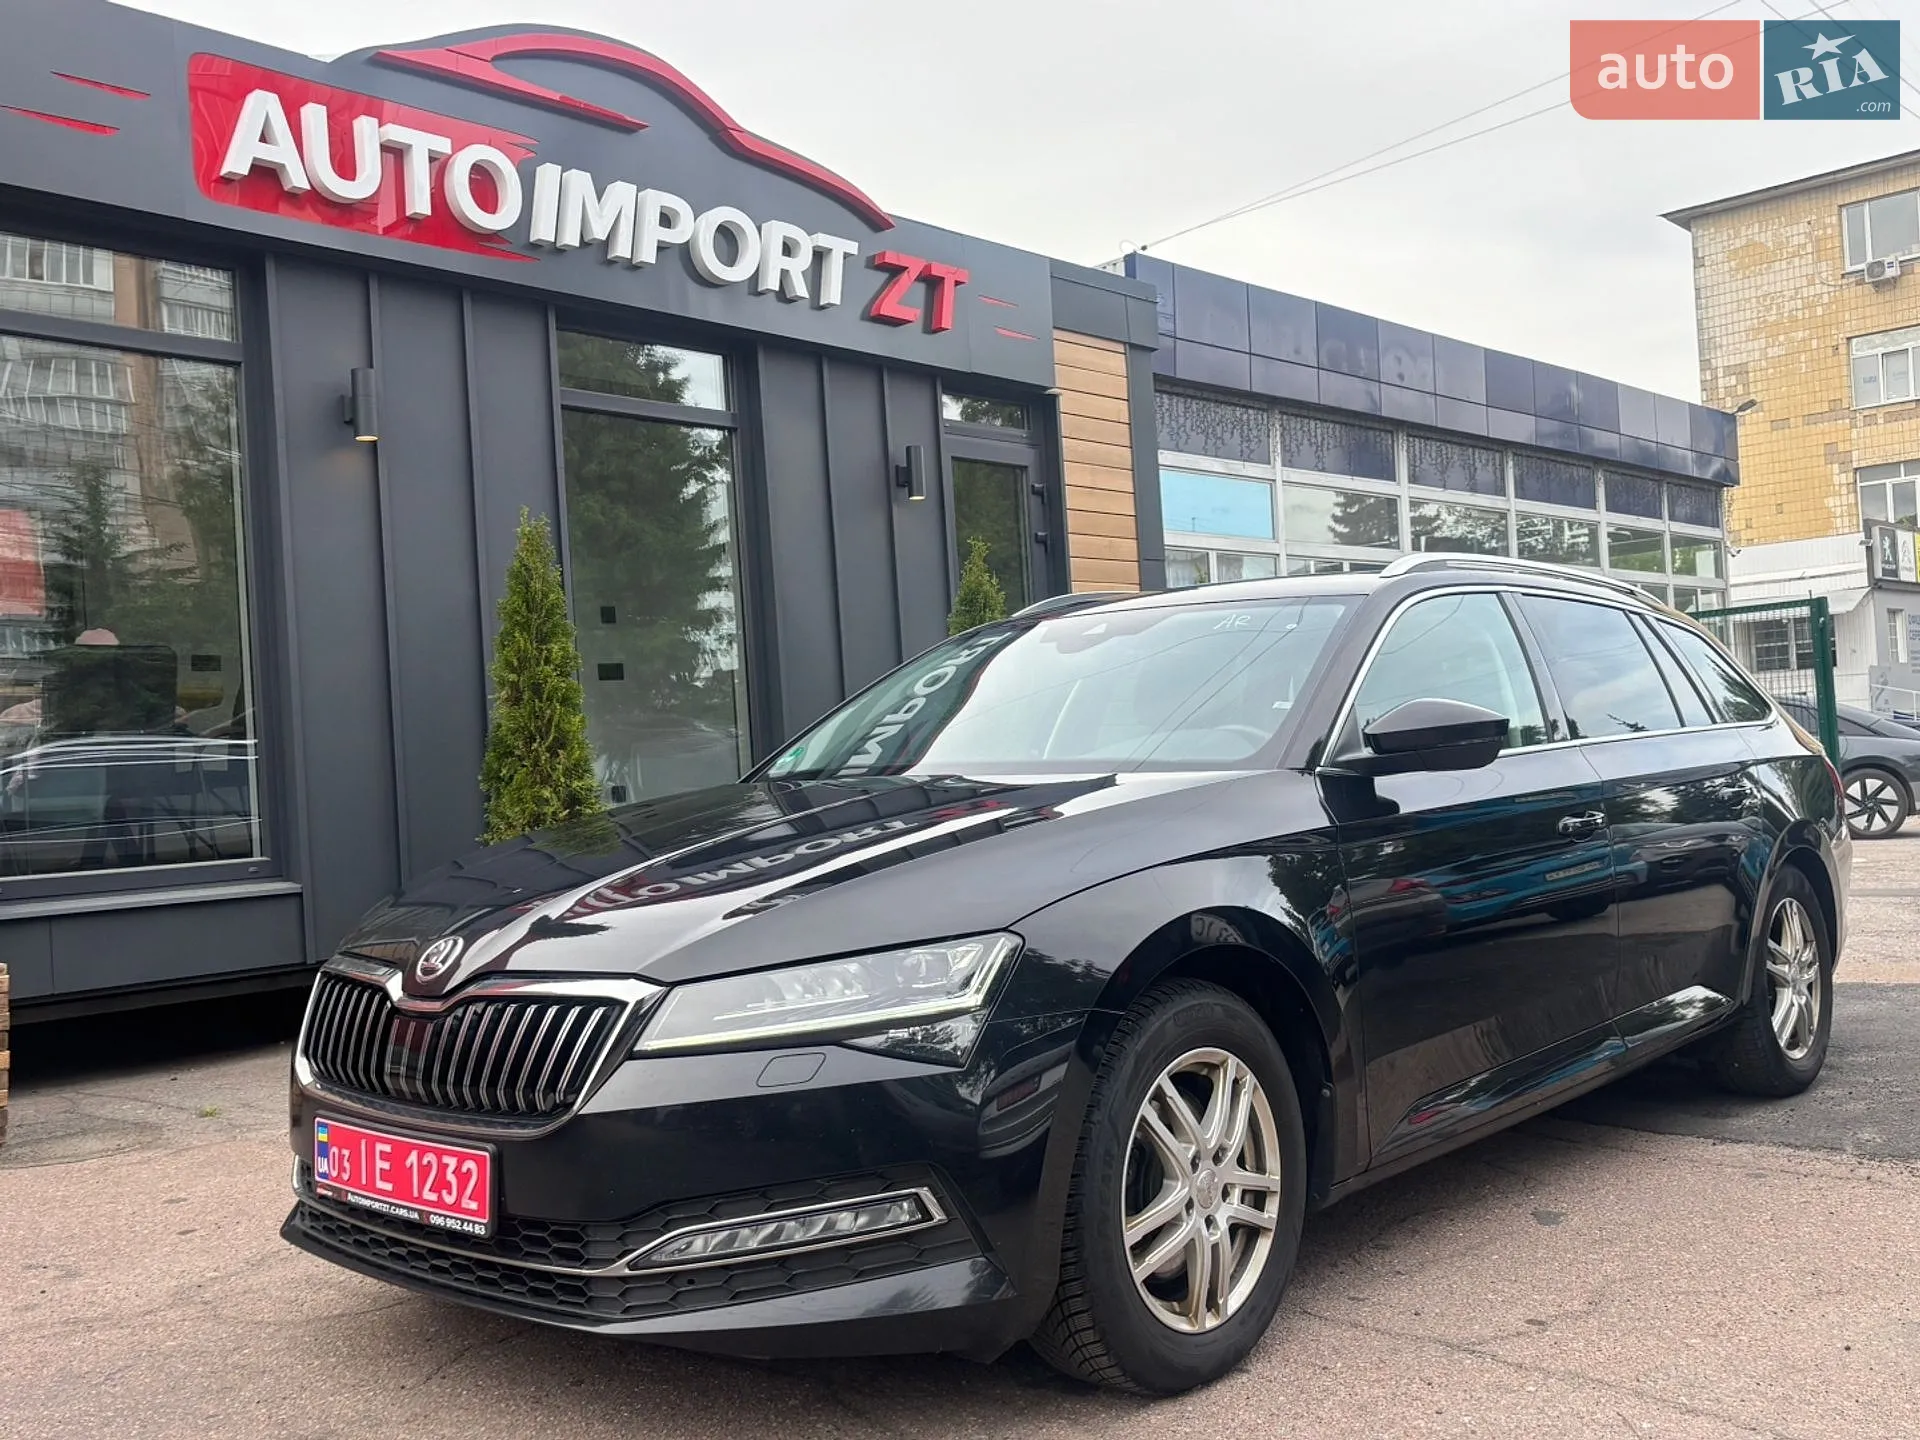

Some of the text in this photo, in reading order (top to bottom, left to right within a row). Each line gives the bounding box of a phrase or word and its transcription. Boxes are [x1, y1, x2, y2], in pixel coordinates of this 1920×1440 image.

[870, 250, 970, 332] ZT
[317, 1156, 329, 1175] UA
[329, 1138, 480, 1211] 03 IE 1232
[429, 1213, 446, 1227] 096
[446, 1217, 462, 1231] 952
[462, 1220, 474, 1232] 44
[474, 1223, 486, 1236] 83
